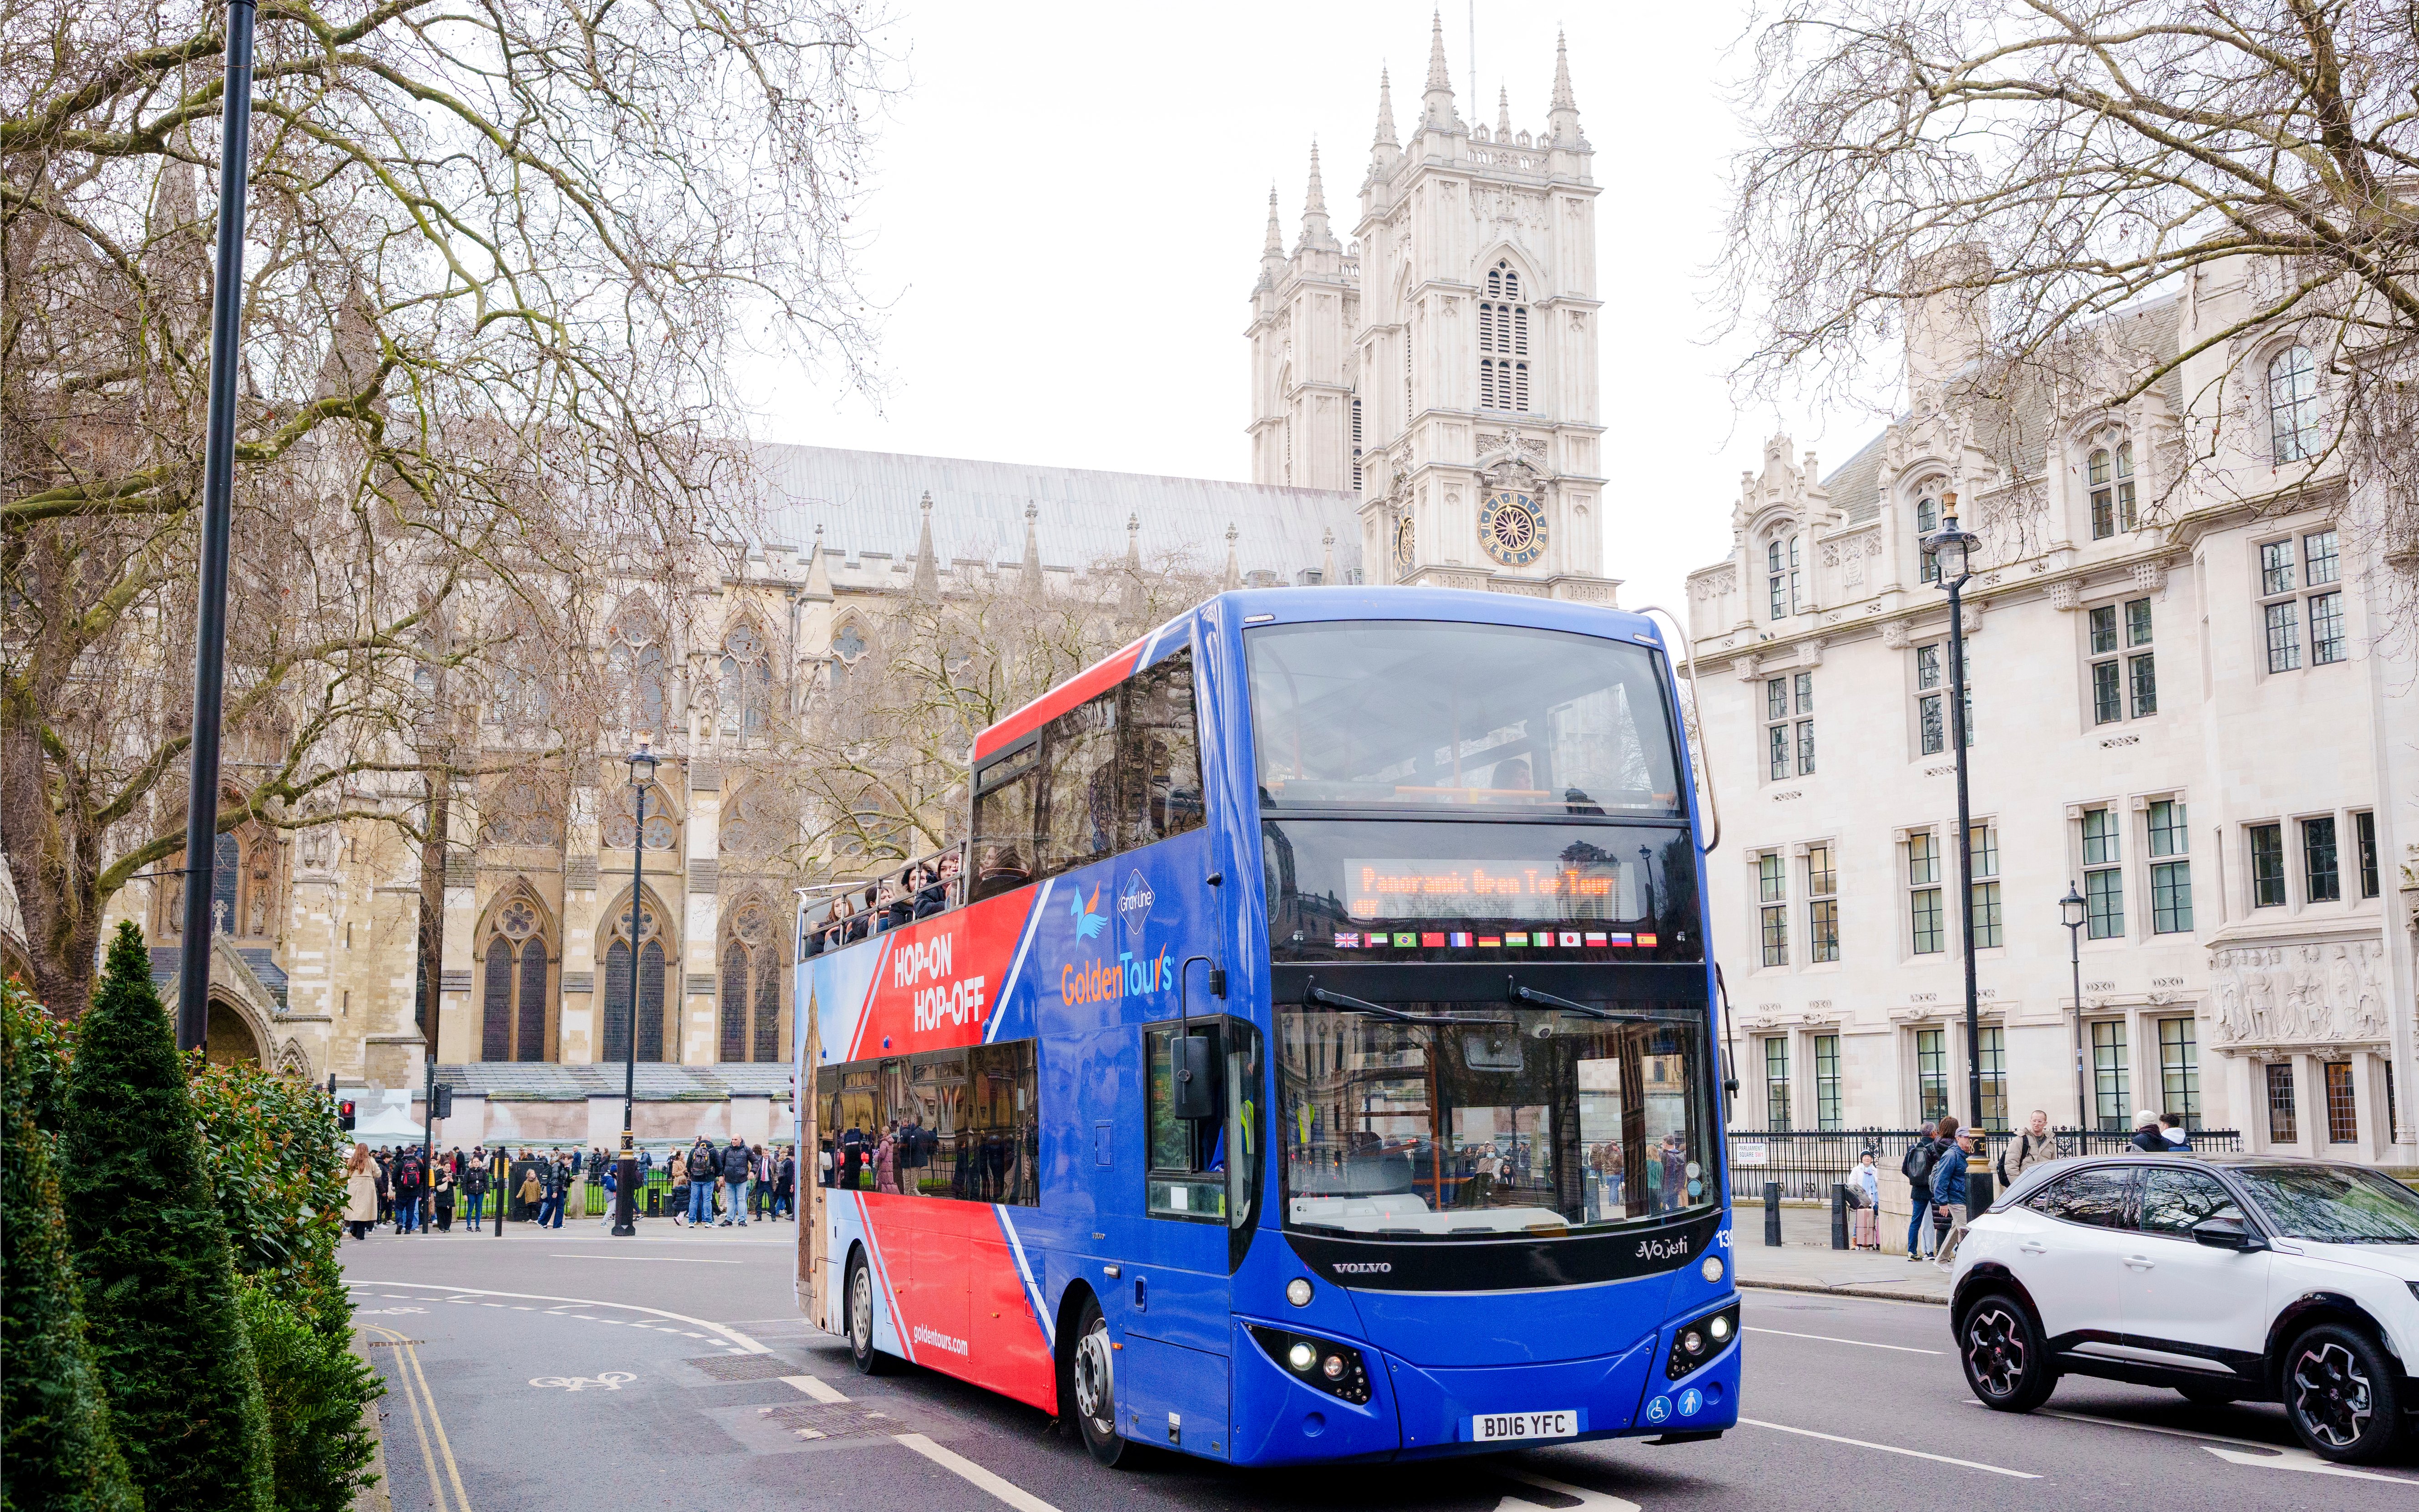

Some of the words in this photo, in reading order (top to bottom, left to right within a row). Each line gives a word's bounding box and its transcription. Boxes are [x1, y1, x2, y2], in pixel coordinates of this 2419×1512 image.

[1363, 868, 1468, 892] Panoramic
[1474, 870, 1519, 893] Open
[1525, 871, 1561, 893] Top
[1566, 871, 1613, 894] Tour
[894, 932, 952, 988] HOP-ON
[914, 975, 984, 1032] HOP-OFF
[1333, 1263, 1392, 1273] VOLVO
[913, 1323, 968, 1356] goldentours.com
[1484, 1416, 1525, 1437] BD16
[1531, 1414, 1565, 1434] YFC
